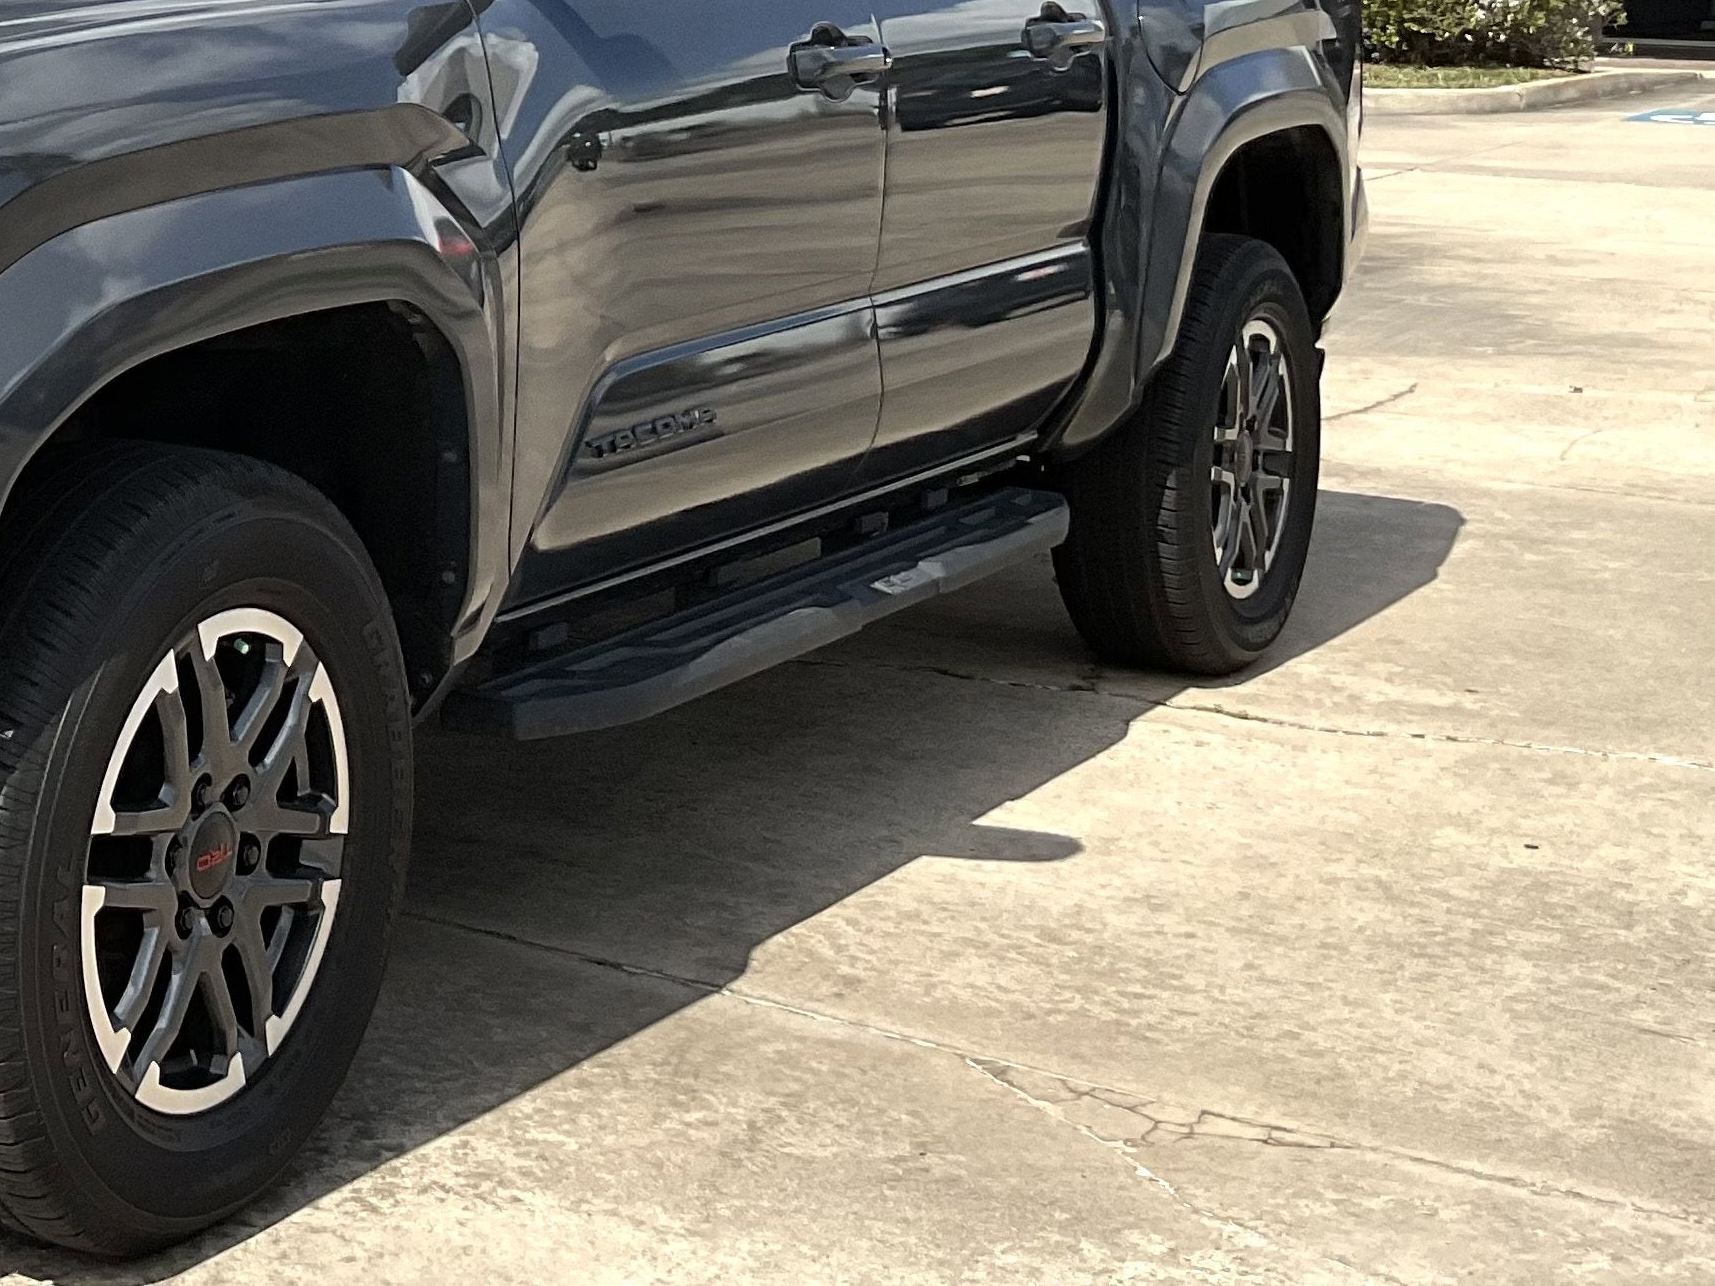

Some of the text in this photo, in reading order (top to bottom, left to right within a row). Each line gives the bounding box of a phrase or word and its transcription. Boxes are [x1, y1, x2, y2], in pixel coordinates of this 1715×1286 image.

[585, 407, 718, 458] TACOMA
[196, 841, 234, 869] TRD
[49, 856, 107, 1137] GENERAL
